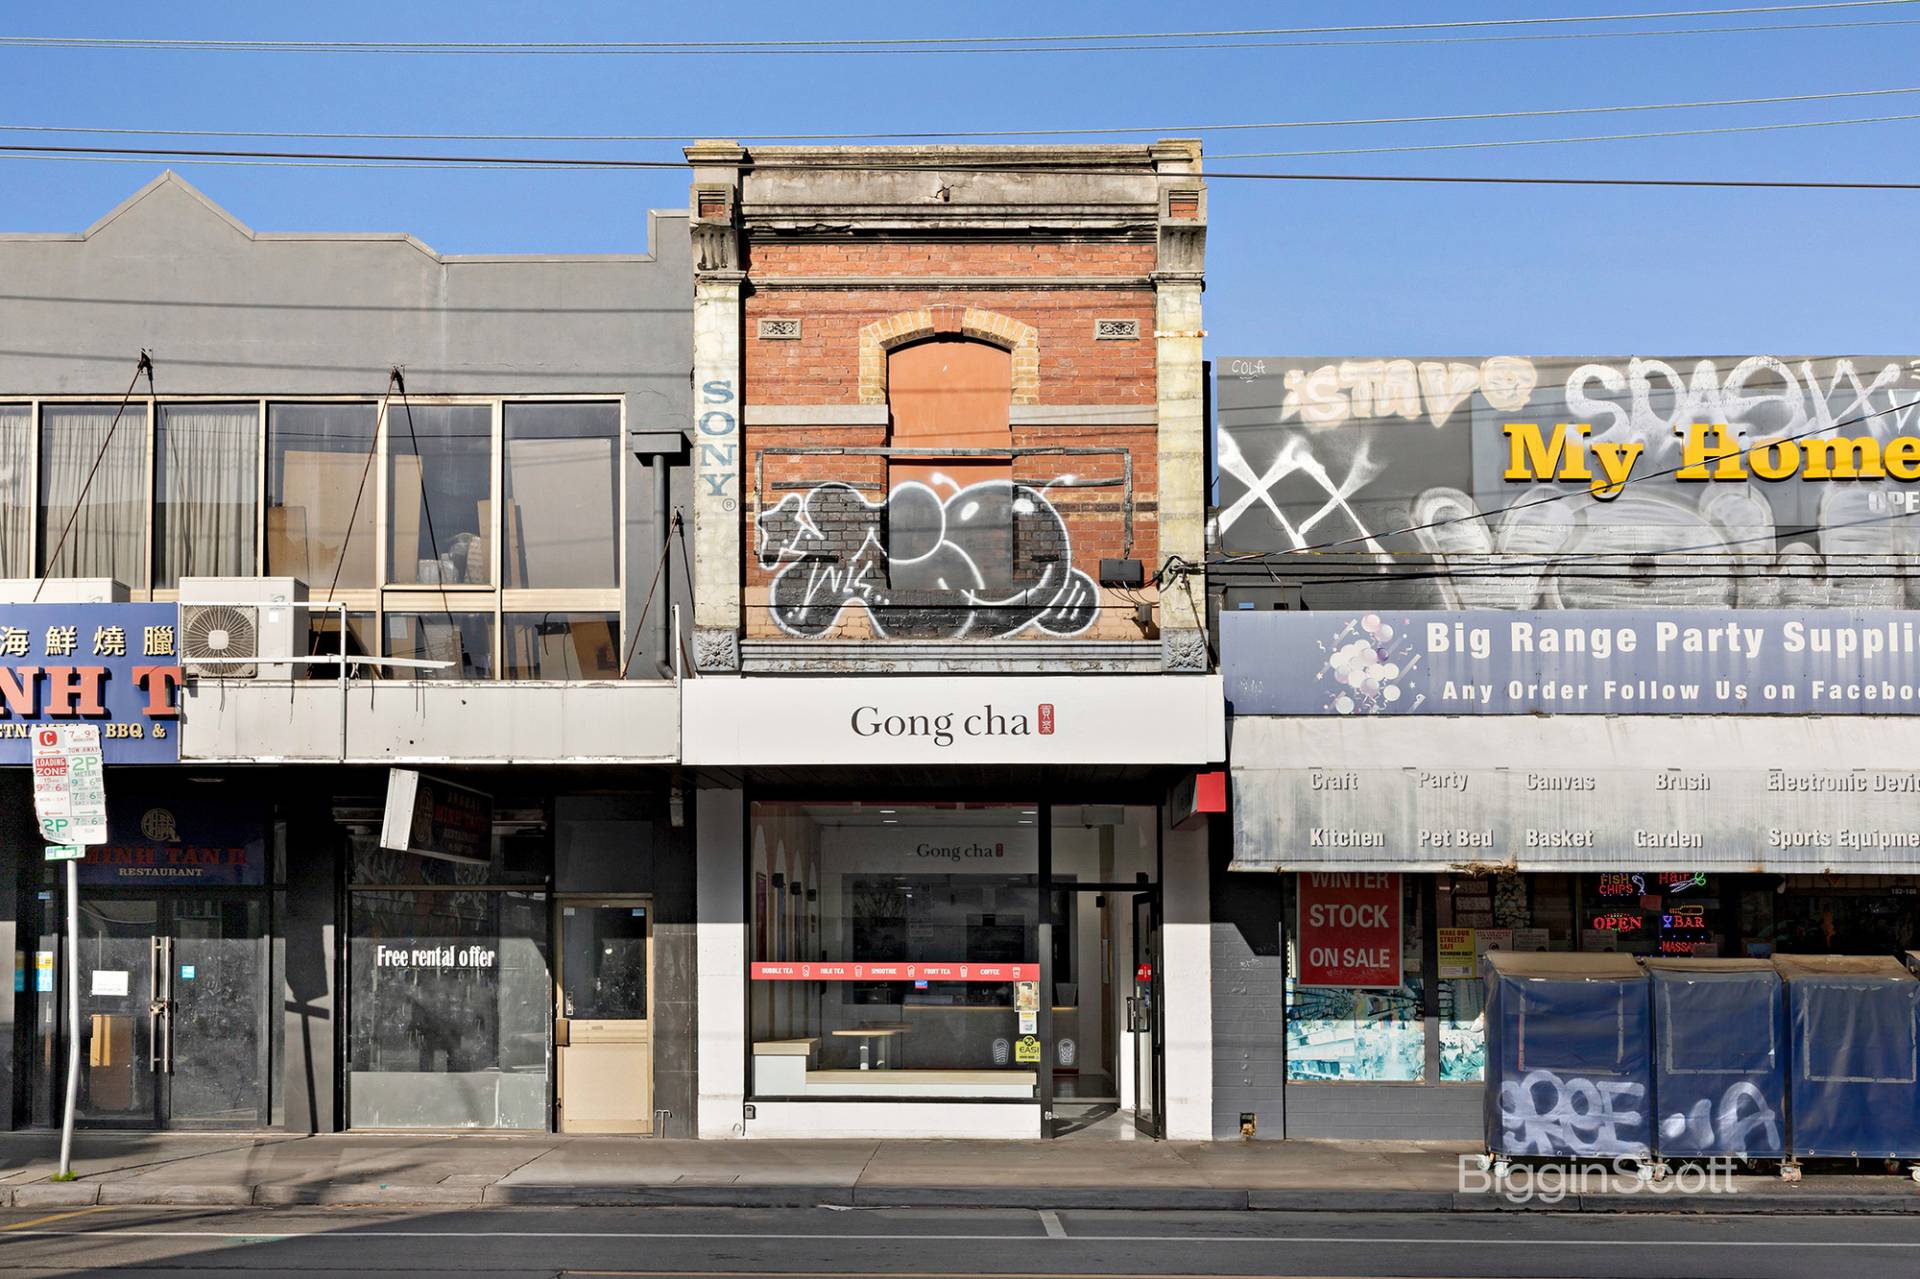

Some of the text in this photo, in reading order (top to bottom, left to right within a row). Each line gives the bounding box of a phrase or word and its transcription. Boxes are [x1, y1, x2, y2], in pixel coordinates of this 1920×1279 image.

[699, 380, 737, 497] SONY
[1503, 423, 1920, 500] My Home
[1427, 621, 1920, 659] Big Range Party Suppli
[132, 666, 184, 716] T
[1442, 680, 1920, 703] Any Order Follow Us on Facebo
[105, 723, 143, 739] BBQ
[153, 723, 166, 739] &
[851, 704, 1031, 747] Gong cha
[36, 758, 66, 767] LOADING
[72, 756, 98, 771] 2P
[36, 767, 67, 776] ZONE
[1311, 772, 1360, 791] Craft
[1418, 771, 1469, 792] Party
[1526, 772, 1596, 791] Canvas
[1655, 773, 1711, 791] Brush
[1767, 772, 1867, 792] Electronic
[42, 818, 69, 832] 2P
[1310, 828, 1385, 848] Kitchen
[1418, 828, 1452, 848] Pet
[1456, 828, 1494, 848] Bed
[1526, 828, 1594, 848] Basket
[1633, 828, 1704, 848] Garden
[1767, 828, 1832, 850] Sports
[916, 843, 961, 863] Gong
[964, 843, 993, 858] cha
[119, 867, 204, 877] RESTAURANT
[1311, 872, 1390, 889] WINTER
[1600, 874, 1629, 884] FISH
[1599, 884, 1633, 895] CHIPS
[1309, 904, 1390, 928] STOCK
[1593, 916, 1643, 930] OPEN
[1674, 916, 1705, 928] BAR
[1662, 941, 1706, 953] MASSA
[377, 945, 495, 967] Free rental offer
[1309, 947, 1391, 968] ON SALE
[871, 967, 897, 975] SMOOTHIE
[980, 968, 1000, 976] COFFEE
